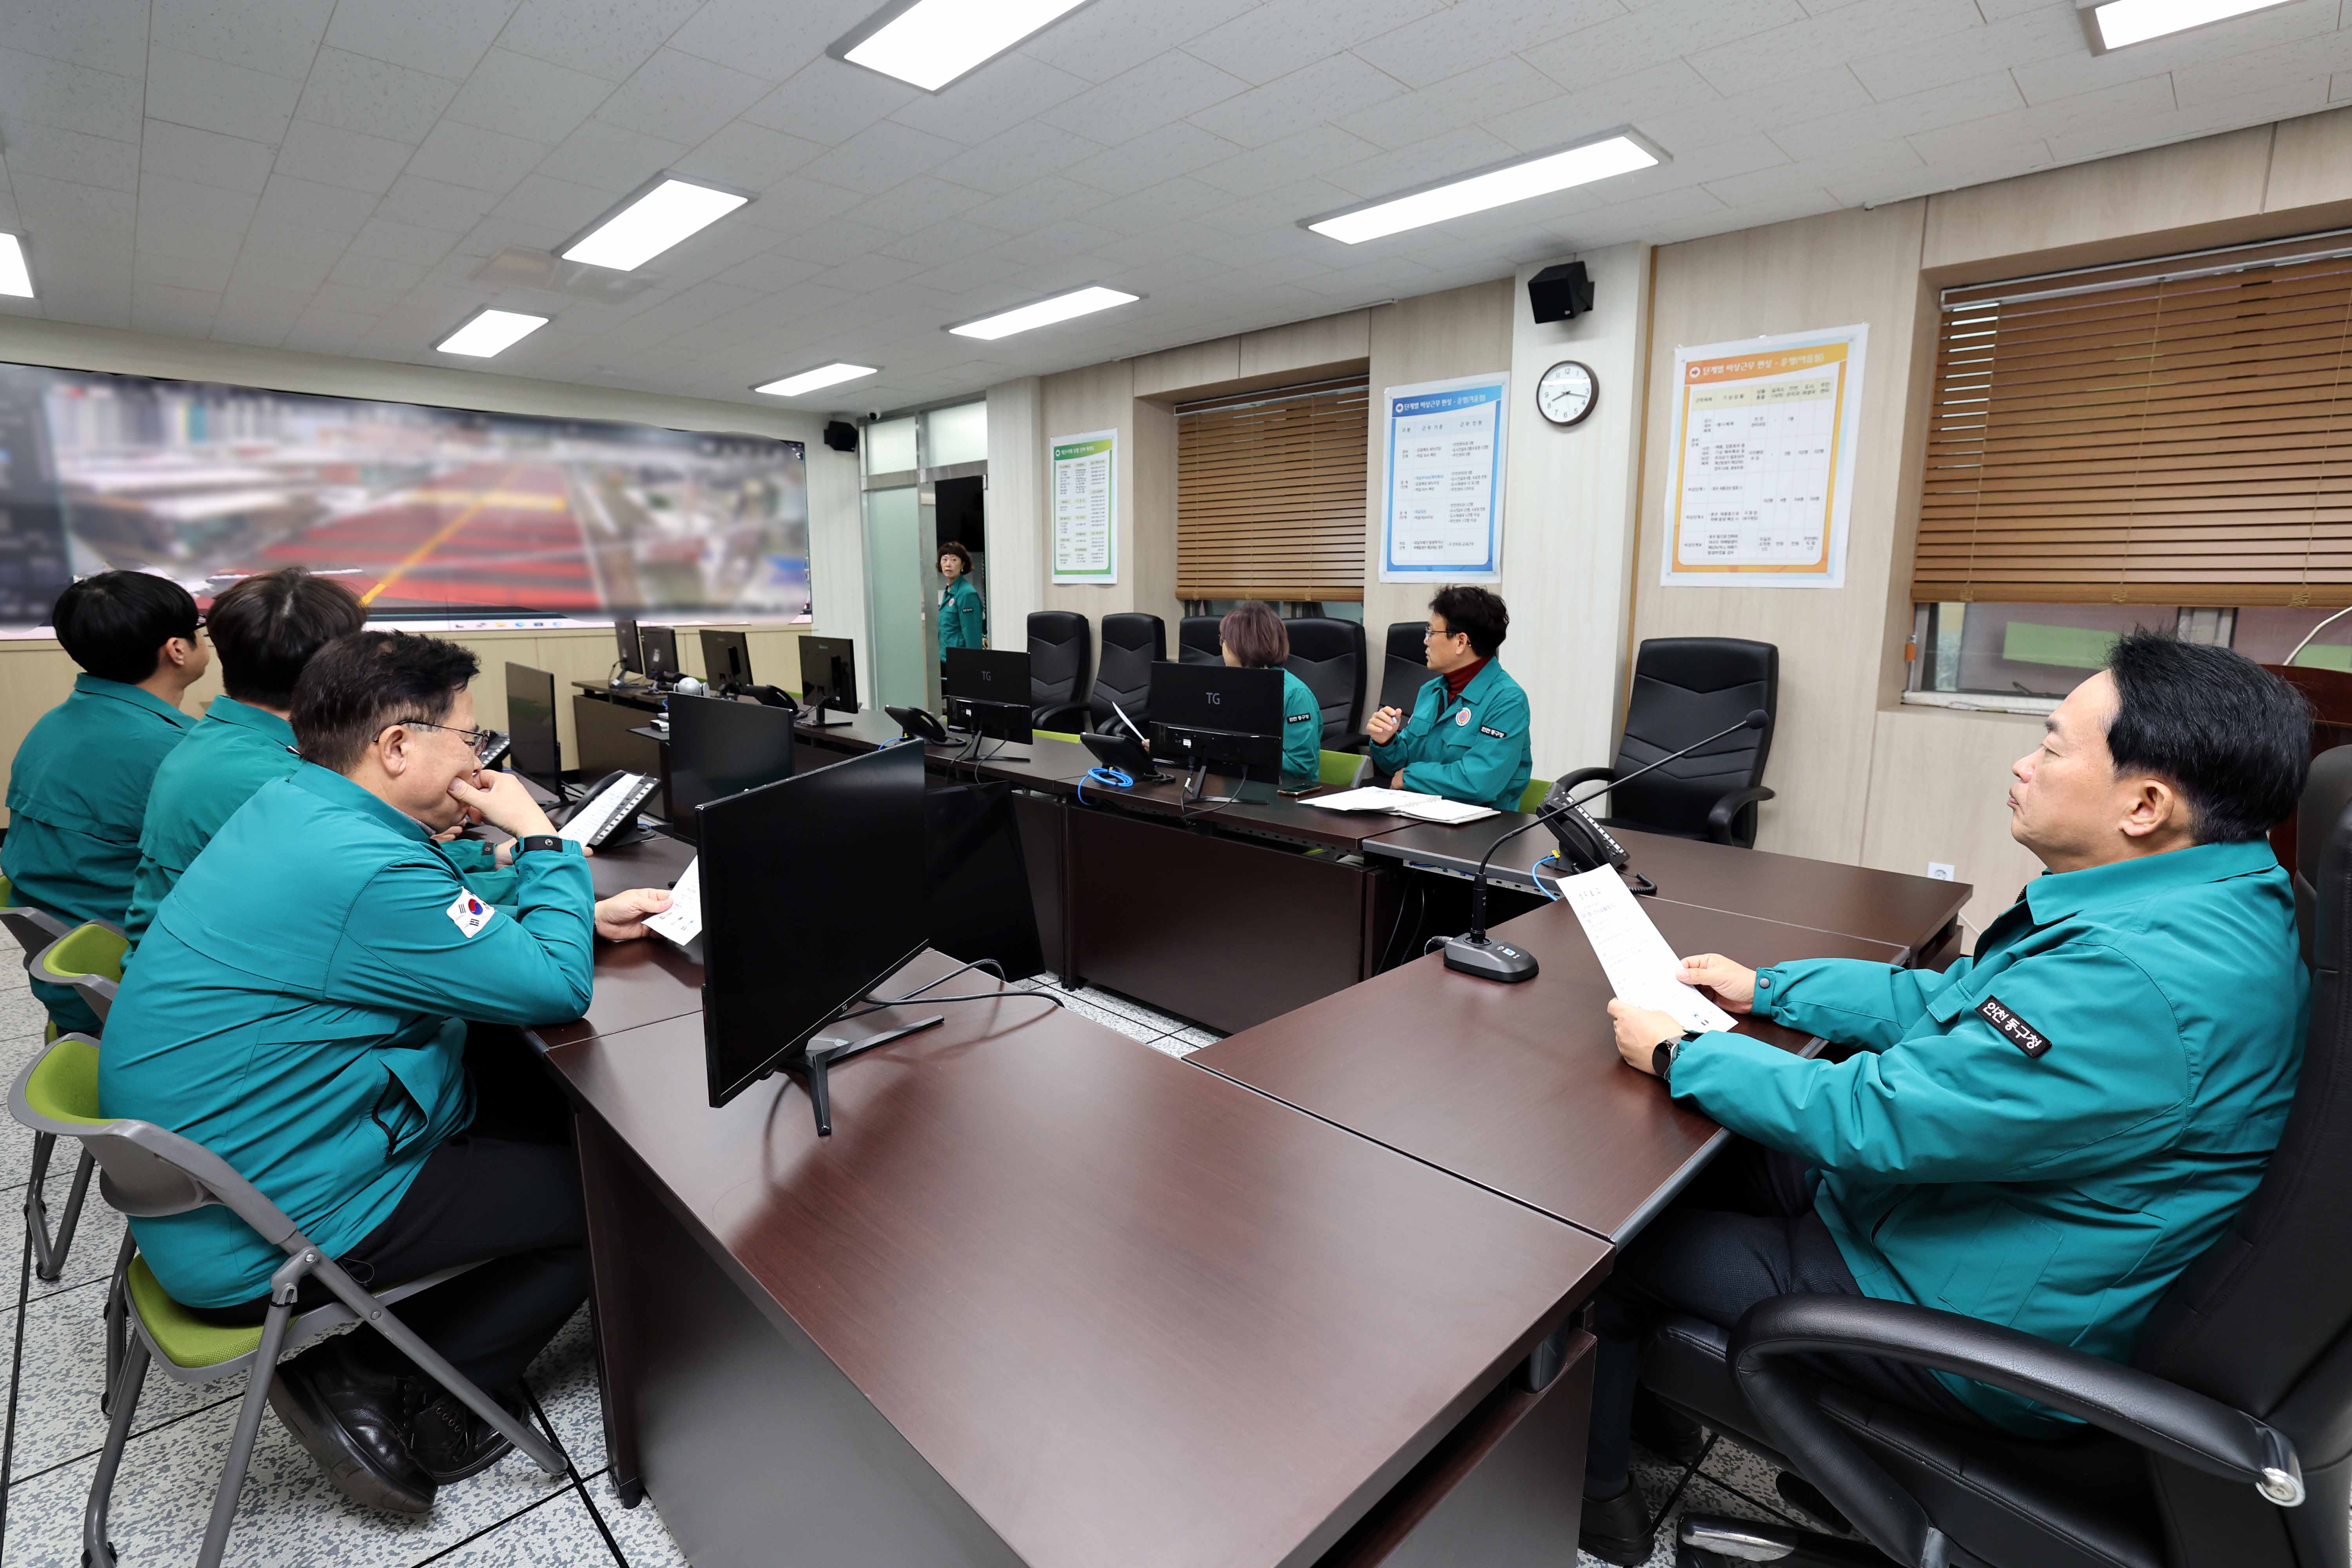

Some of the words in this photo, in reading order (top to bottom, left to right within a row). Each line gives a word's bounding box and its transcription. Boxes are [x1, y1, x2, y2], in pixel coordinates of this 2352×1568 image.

[1703, 365, 1723, 376] 단계별
[1726, 362, 1754, 372] 비상근무
[1404, 402, 1419, 410] 단계별
[1420, 399, 1440, 408] 비상근무
[1441, 398, 1452, 406] 편성
[981, 671, 991, 681] TG
[1206, 692, 1220, 705] TG
[1491, 730, 1504, 738] 동구청
[842, 1003, 847, 1012] TG
[1982, 1002, 2009, 1024] 인천
[2005, 1018, 2042, 1049] 동구청
